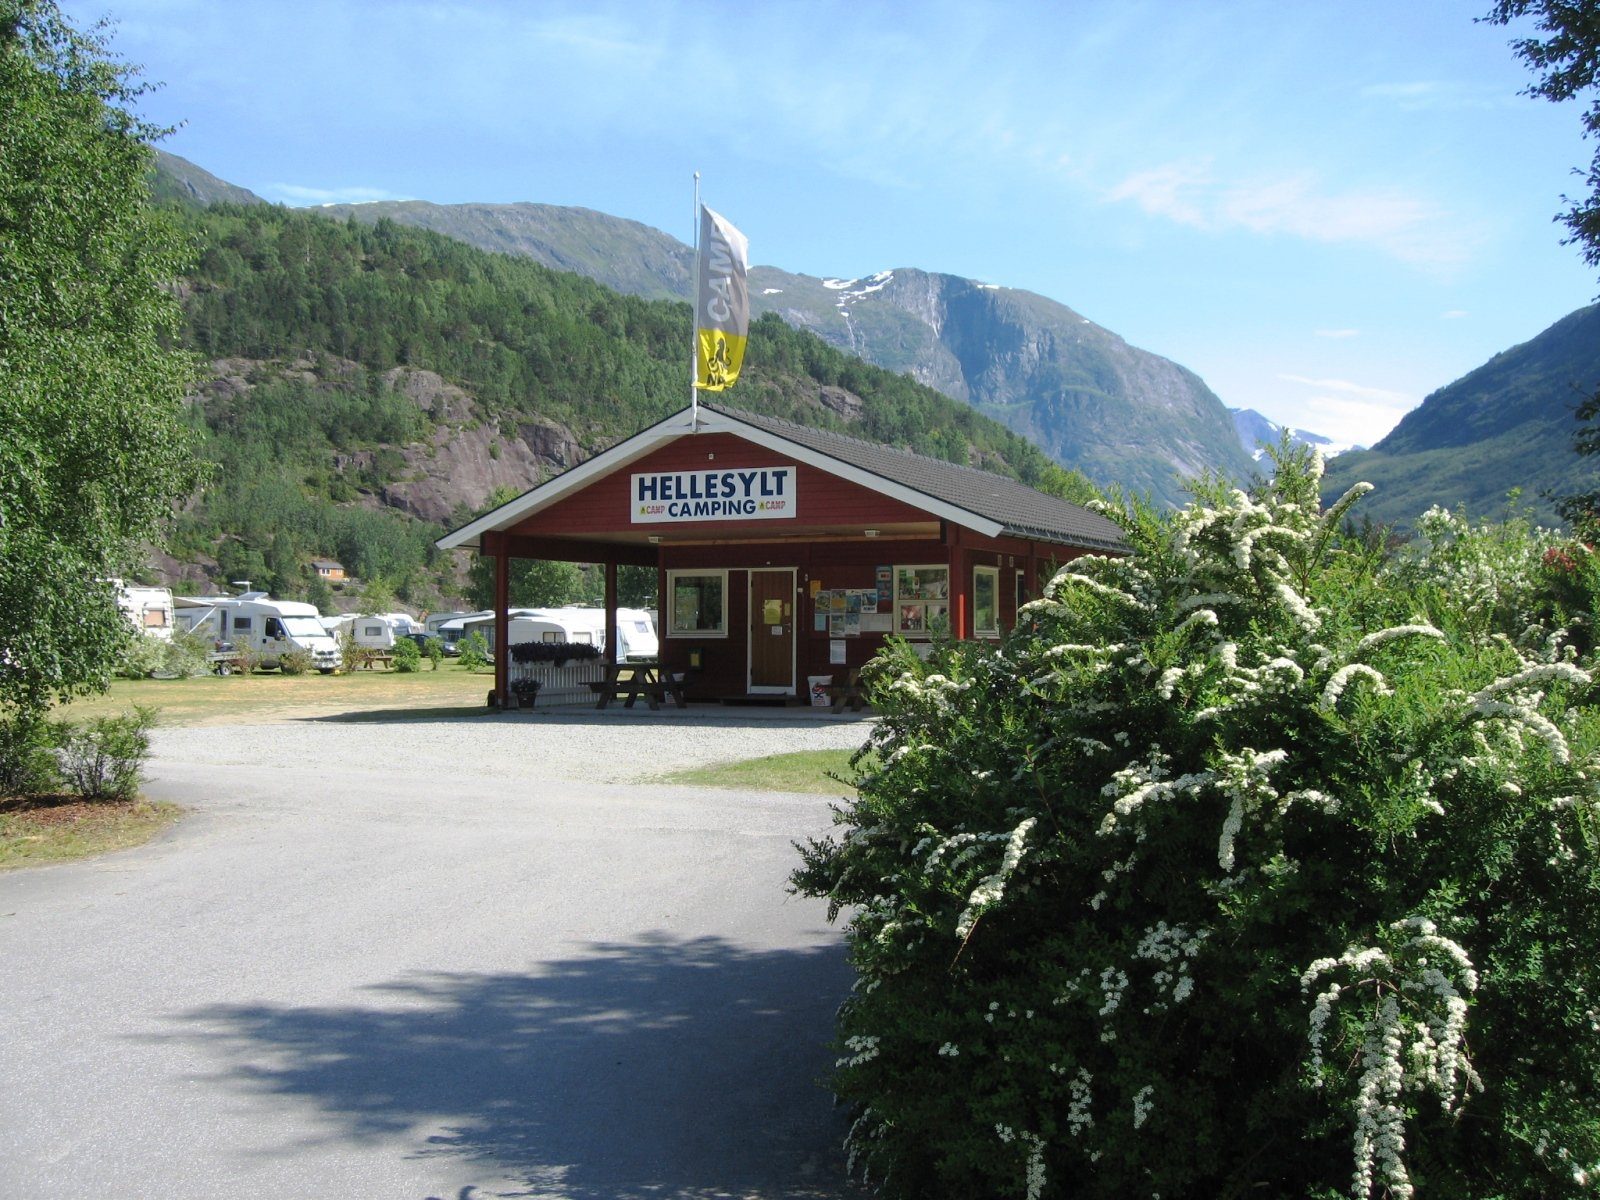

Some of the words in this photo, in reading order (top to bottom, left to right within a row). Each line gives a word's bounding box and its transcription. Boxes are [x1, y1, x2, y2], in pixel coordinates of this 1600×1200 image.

[639, 471, 787, 501] HELLESYLT
[646, 505, 665, 514] CAMP
[668, 500, 756, 517] CAMPING
[765, 500, 786, 510] CAMP
